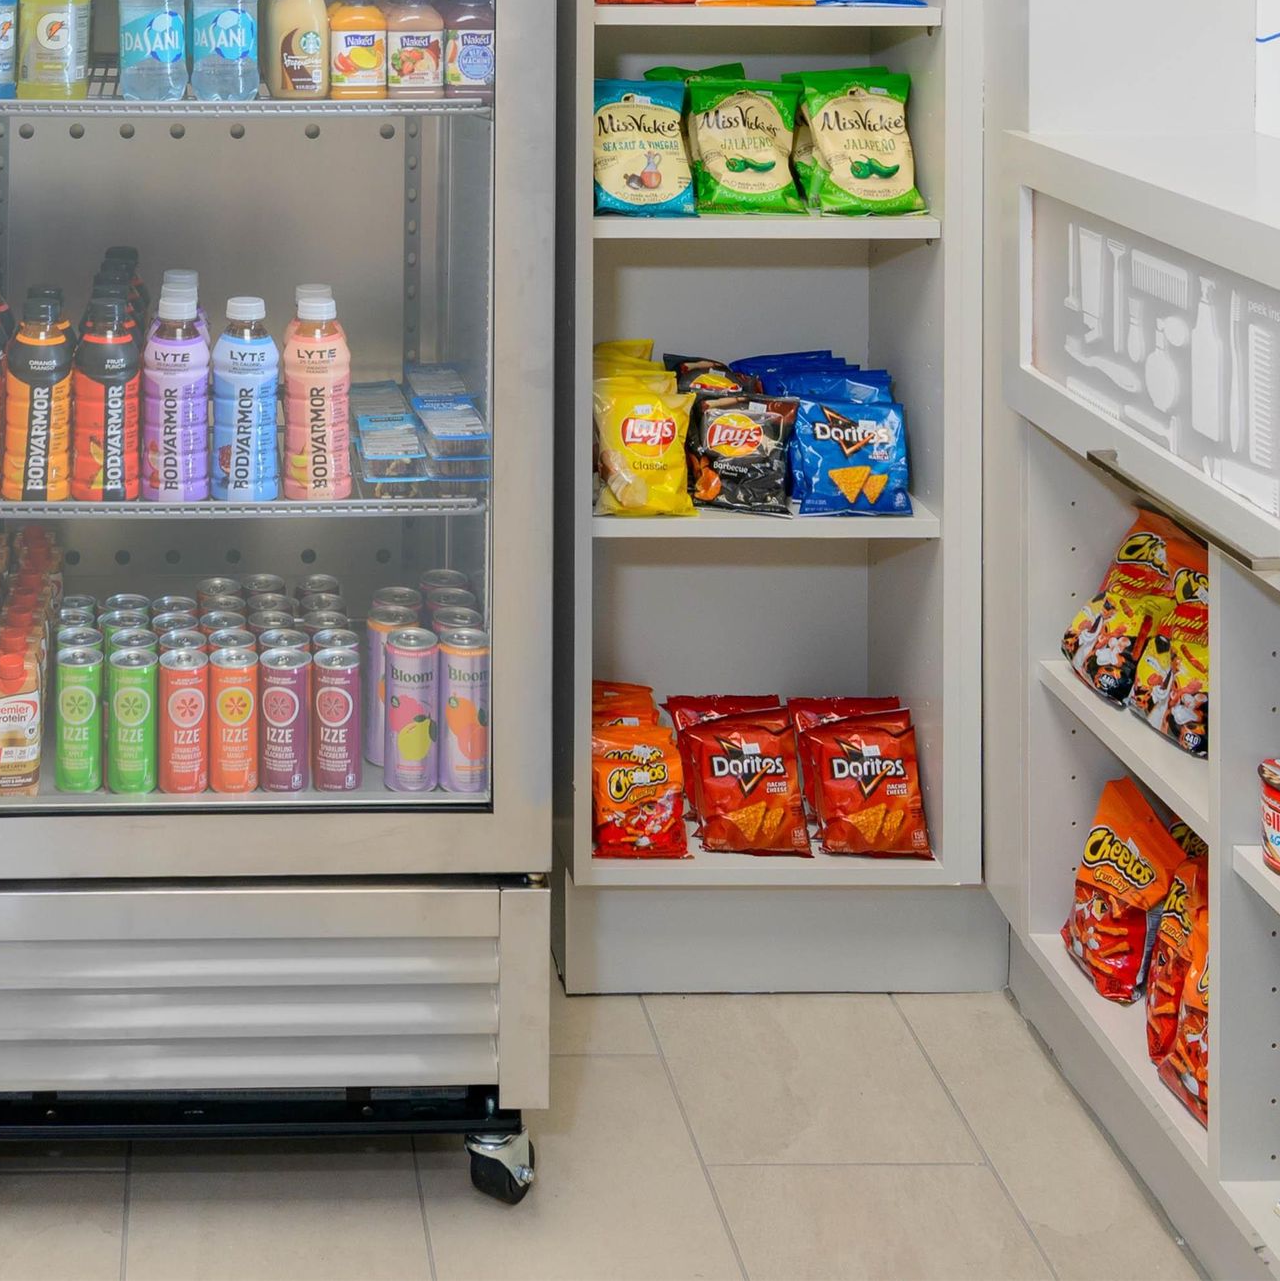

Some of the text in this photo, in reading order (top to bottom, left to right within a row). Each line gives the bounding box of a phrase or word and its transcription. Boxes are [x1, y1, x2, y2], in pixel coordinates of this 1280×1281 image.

[194, 23, 247, 53] DASANI
[346, 34, 374, 47] Naked
[402, 36, 430, 48] Naked
[463, 34, 491, 46] Naked
[461, 56, 493, 66] MACHINE
[154, 351, 190, 363] LYTE
[229, 350, 265, 362] LYTE
[297, 348, 337, 360] LYTE
[26, 387, 50, 491] BODYARMOR
[106, 385, 123, 491] BODYARMOR
[163, 387, 178, 491] BODYARMOR
[233, 387, 254, 490] BODYARMOR
[310, 386, 328, 490] BODYARMOR
[625, 419, 673, 444] Lay's
[713, 423, 761, 446] Lay's
[813, 422, 890, 443] Doritos
[632, 461, 668, 472] Classic
[713, 461, 749, 475] Barbecue
[390, 667, 434, 683] Bloom
[64, 727, 89, 741] IZZE
[118, 728, 144, 742] IZZE
[174, 729, 200, 744] IZZE
[222, 728, 248, 743] IZZE
[266, 728, 293, 743] IZZE
[320, 728, 347, 743] IZZE
[711, 754, 785, 778] Doritos
[831, 756, 905, 779] Doritos
[1082, 827, 1156, 888] Cheetos
[1093, 867, 1131, 894] Crunchy
